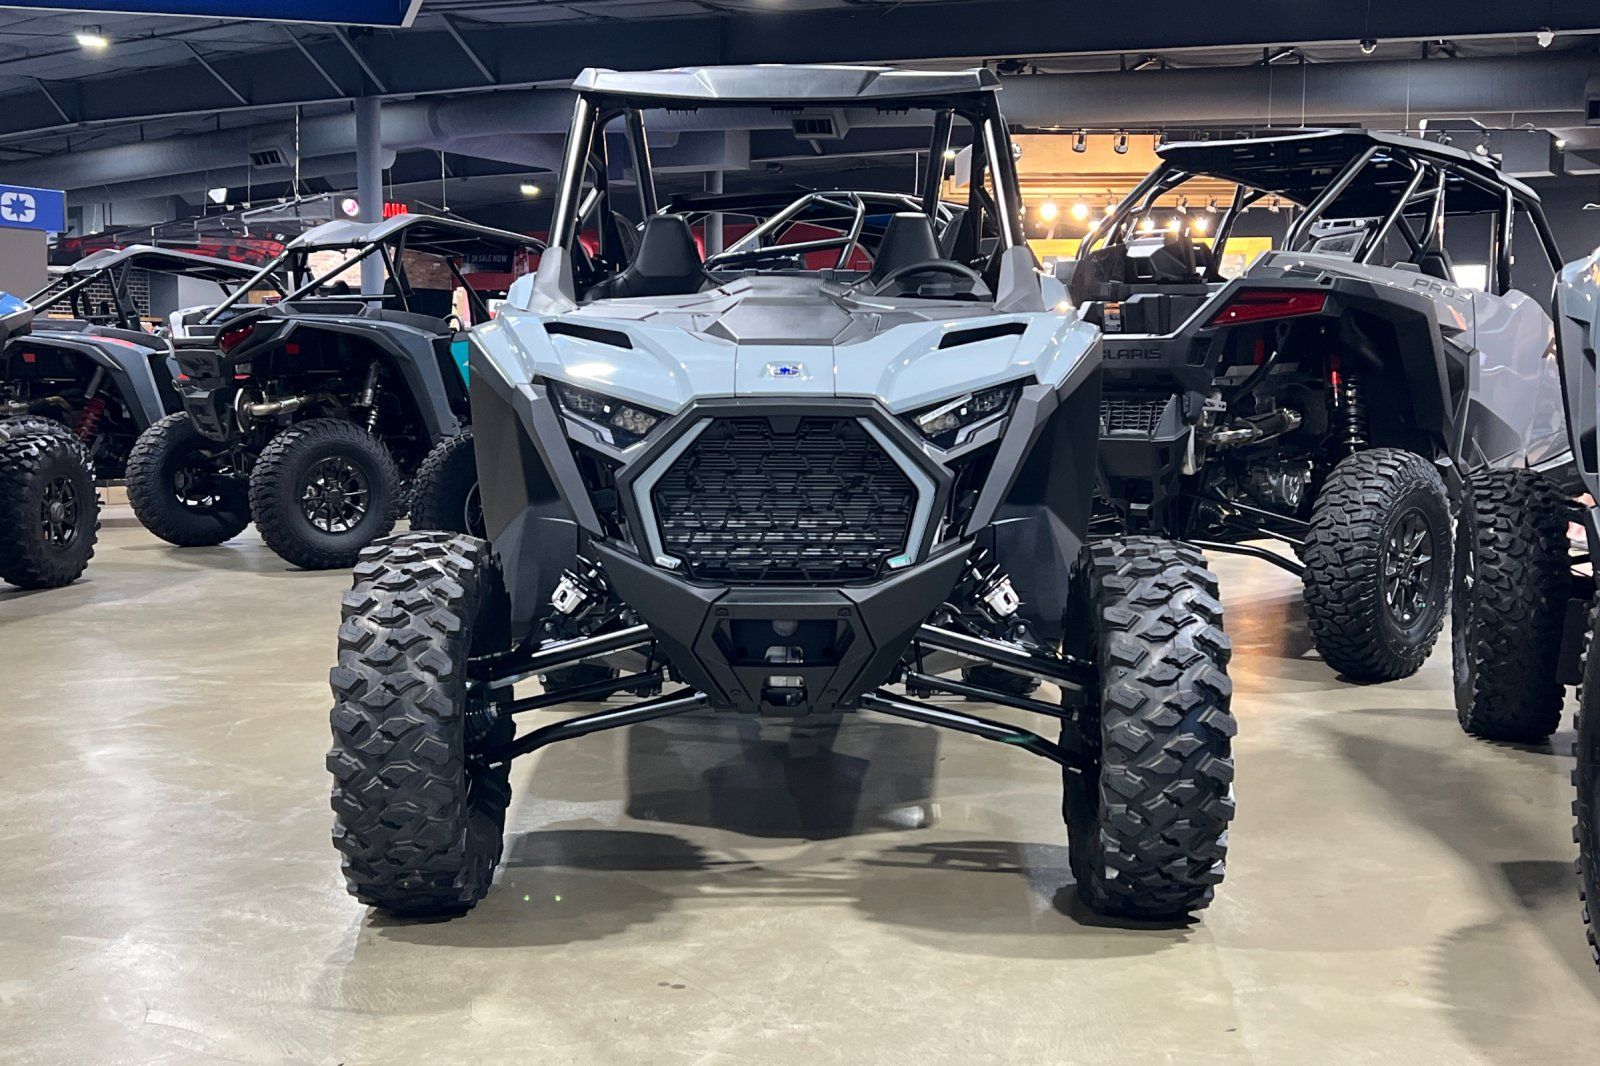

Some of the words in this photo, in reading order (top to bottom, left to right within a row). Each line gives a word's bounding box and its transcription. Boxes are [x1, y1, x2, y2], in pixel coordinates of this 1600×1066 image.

[382, 202, 408, 217] AHA
[492, 254, 508, 263] NOW
[1413, 279, 1455, 298] PRO
[1103, 348, 1161, 360] LARIS
